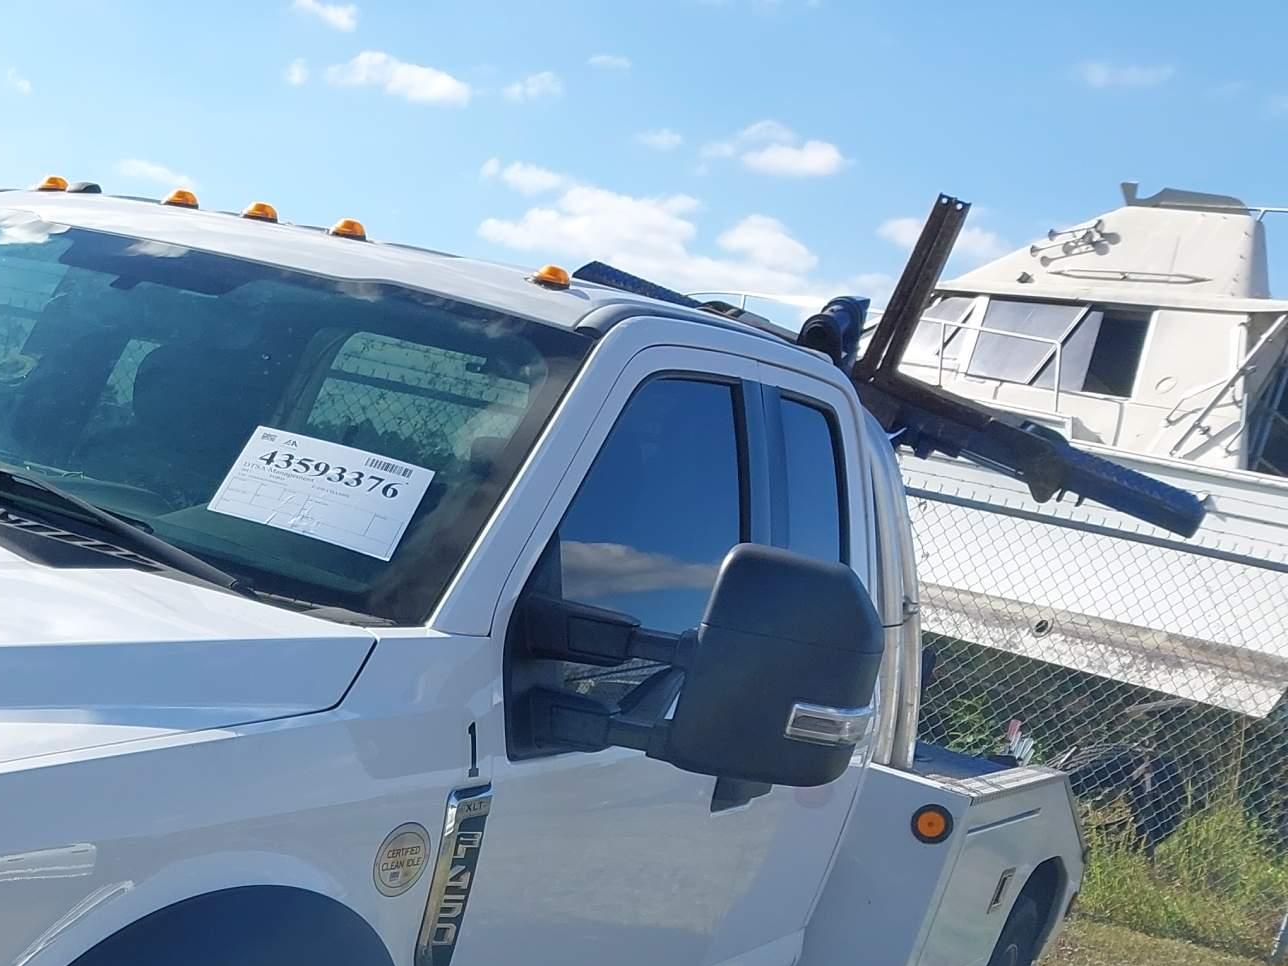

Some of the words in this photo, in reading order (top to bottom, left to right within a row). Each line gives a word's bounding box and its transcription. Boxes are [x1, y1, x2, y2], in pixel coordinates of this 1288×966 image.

[259, 449, 403, 499] 43593376
[465, 801, 485, 813] XLT
[386, 845, 422, 859] CERTIFIED
[381, 859, 405, 872] CLEAN
[406, 856, 423, 869] IDLE
